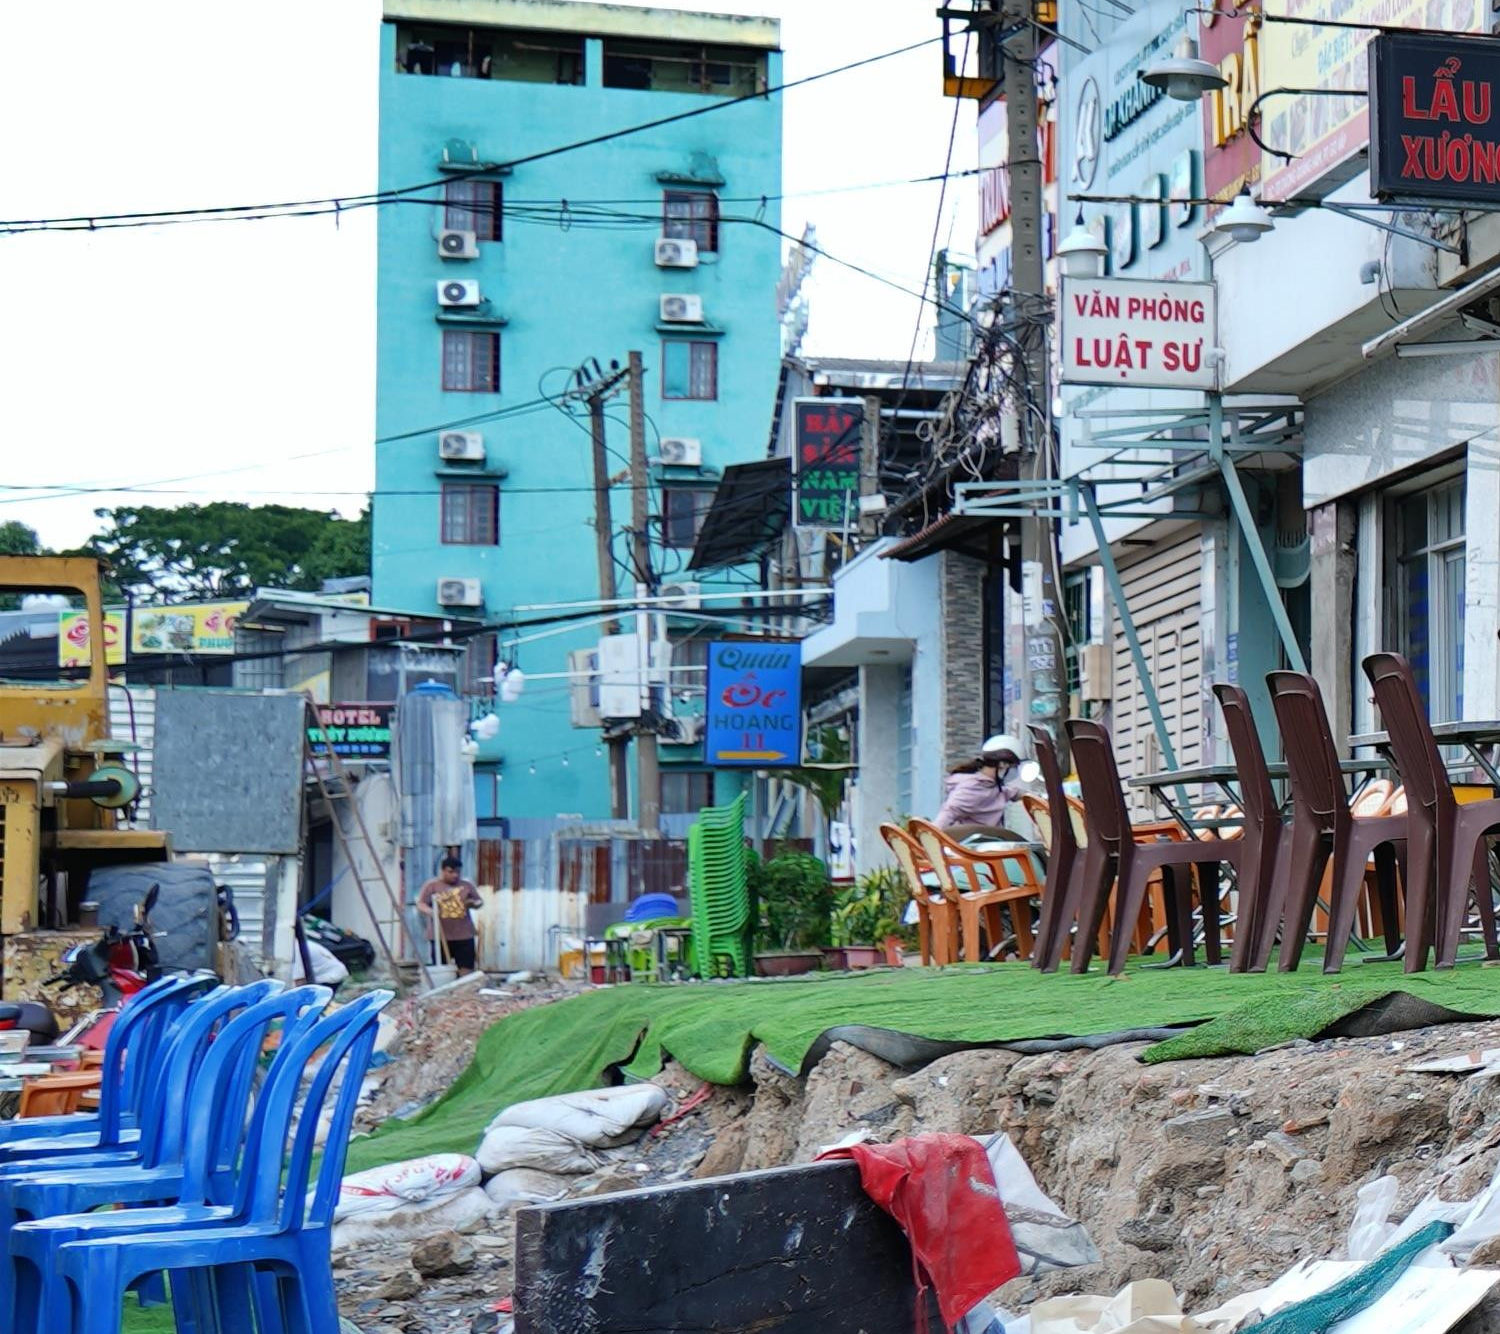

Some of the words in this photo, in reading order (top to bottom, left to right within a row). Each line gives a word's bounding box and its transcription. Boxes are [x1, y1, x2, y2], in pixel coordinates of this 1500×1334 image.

[1403, 57, 1491, 125] LẨU
[1074, 289, 1120, 319] VĂN
[1127, 292, 1205, 324] PHÒNG
[1076, 332, 1152, 378] LUẬT
[1163, 338, 1204, 372] SƯ
[320, 709, 381, 725] HOTEL
